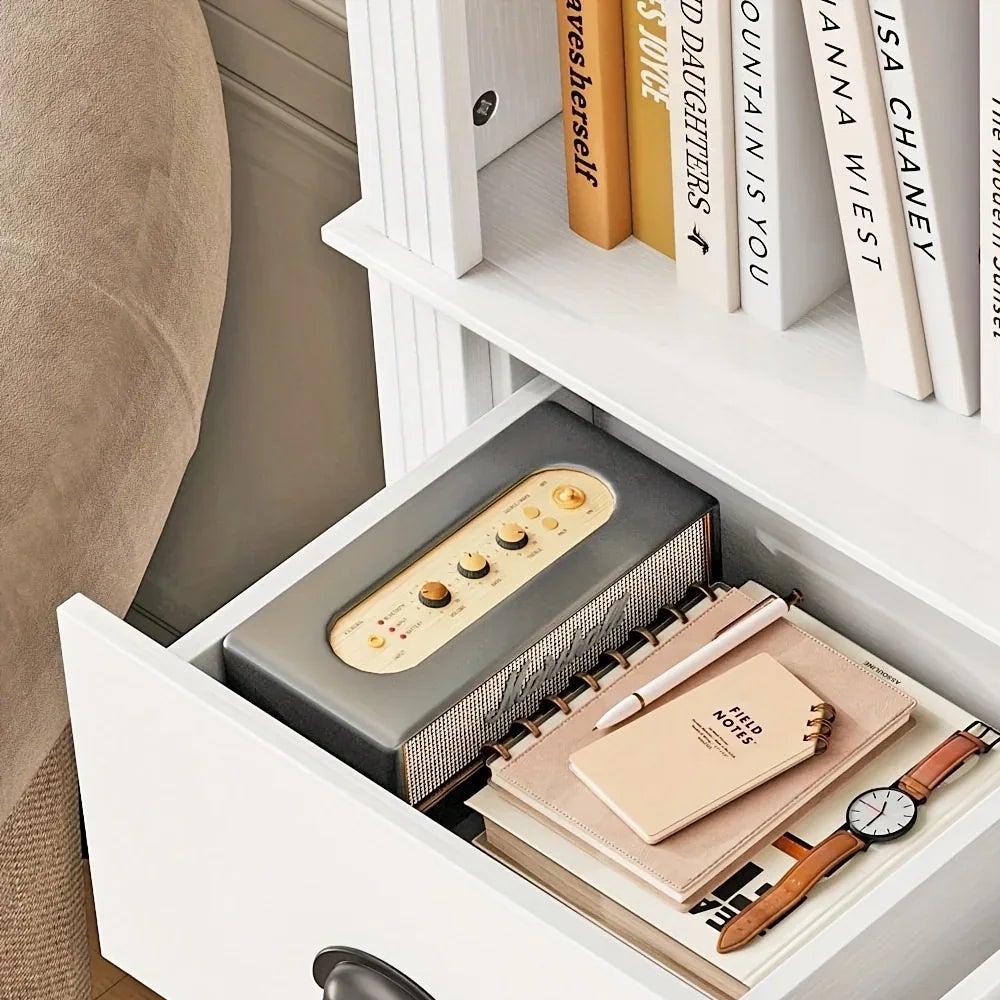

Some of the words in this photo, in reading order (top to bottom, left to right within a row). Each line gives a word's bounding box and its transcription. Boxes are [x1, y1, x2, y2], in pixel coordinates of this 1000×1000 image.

[636, 0, 666, 27] S
[638, 24, 670, 111] JOYCE
[740, 0, 764, 160] OUNTAIN
[569, 67, 598, 188] herself
[680, 25, 711, 215] DAUGHTERS
[874, 9, 904, 71] ISA
[889, 97, 936, 261] CHANEY
[746, 170, 766, 203] IS
[842, 153, 882, 271] WIEST
[747, 216, 769, 287] YOU
[863, 660, 901, 685] ASSOULINE
[712, 710, 754, 745] NOTES
[728, 706, 763, 735] FIELD
